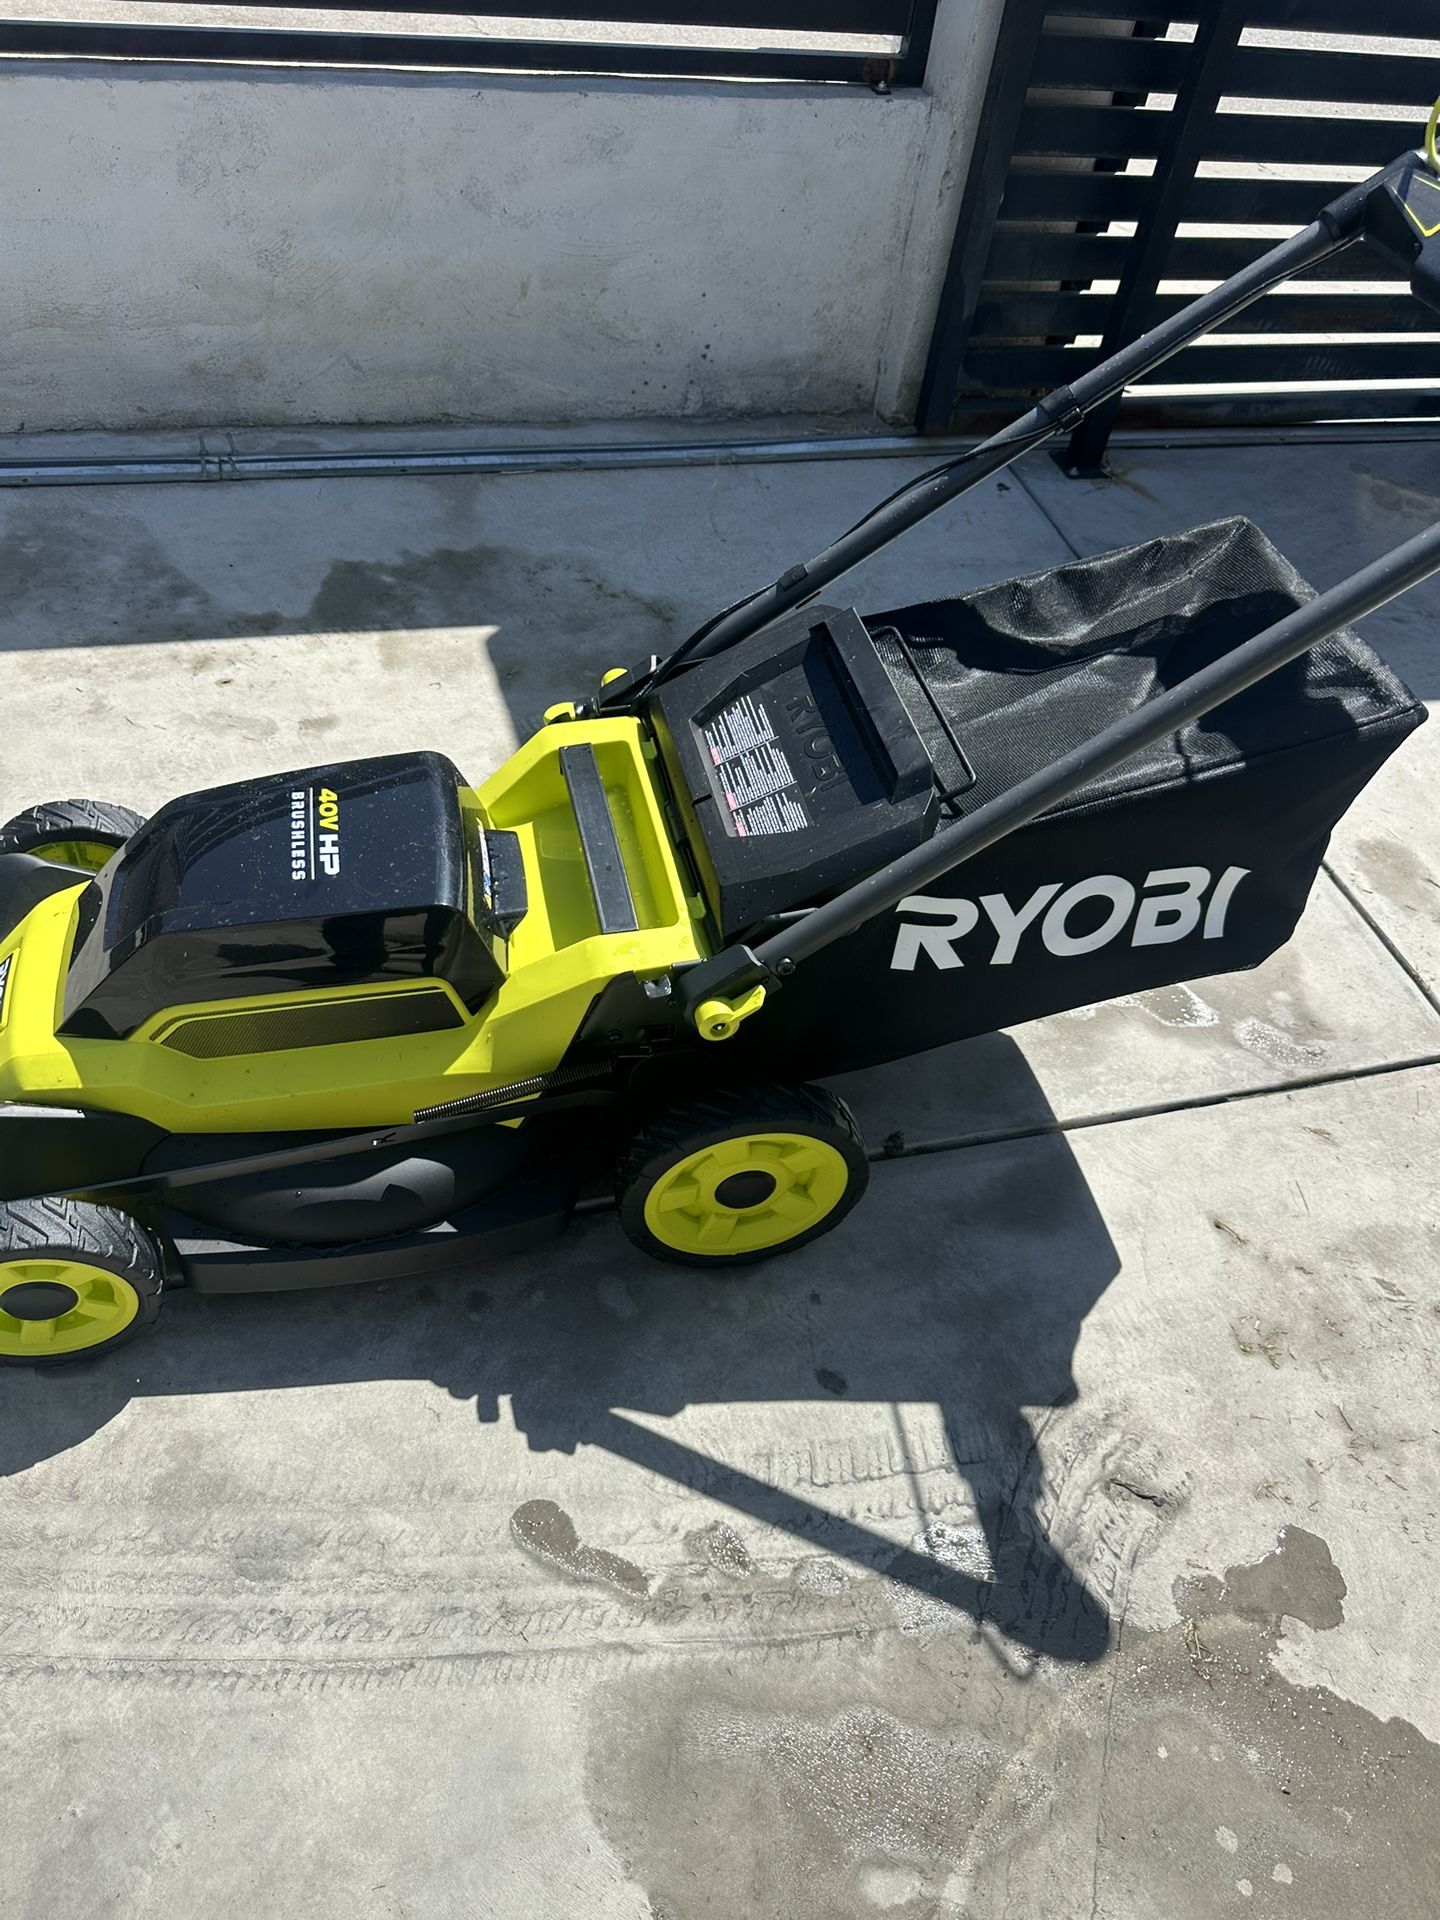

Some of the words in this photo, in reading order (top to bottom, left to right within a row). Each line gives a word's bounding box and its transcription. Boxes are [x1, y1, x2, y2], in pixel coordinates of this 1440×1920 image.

[786, 694, 856, 792] RYOBI
[291, 791, 306, 880] BRUSHLESS
[319, 788, 339, 831] 40V
[319, 834, 340, 875] HP
[890, 866, 1251, 971] RYOBI
